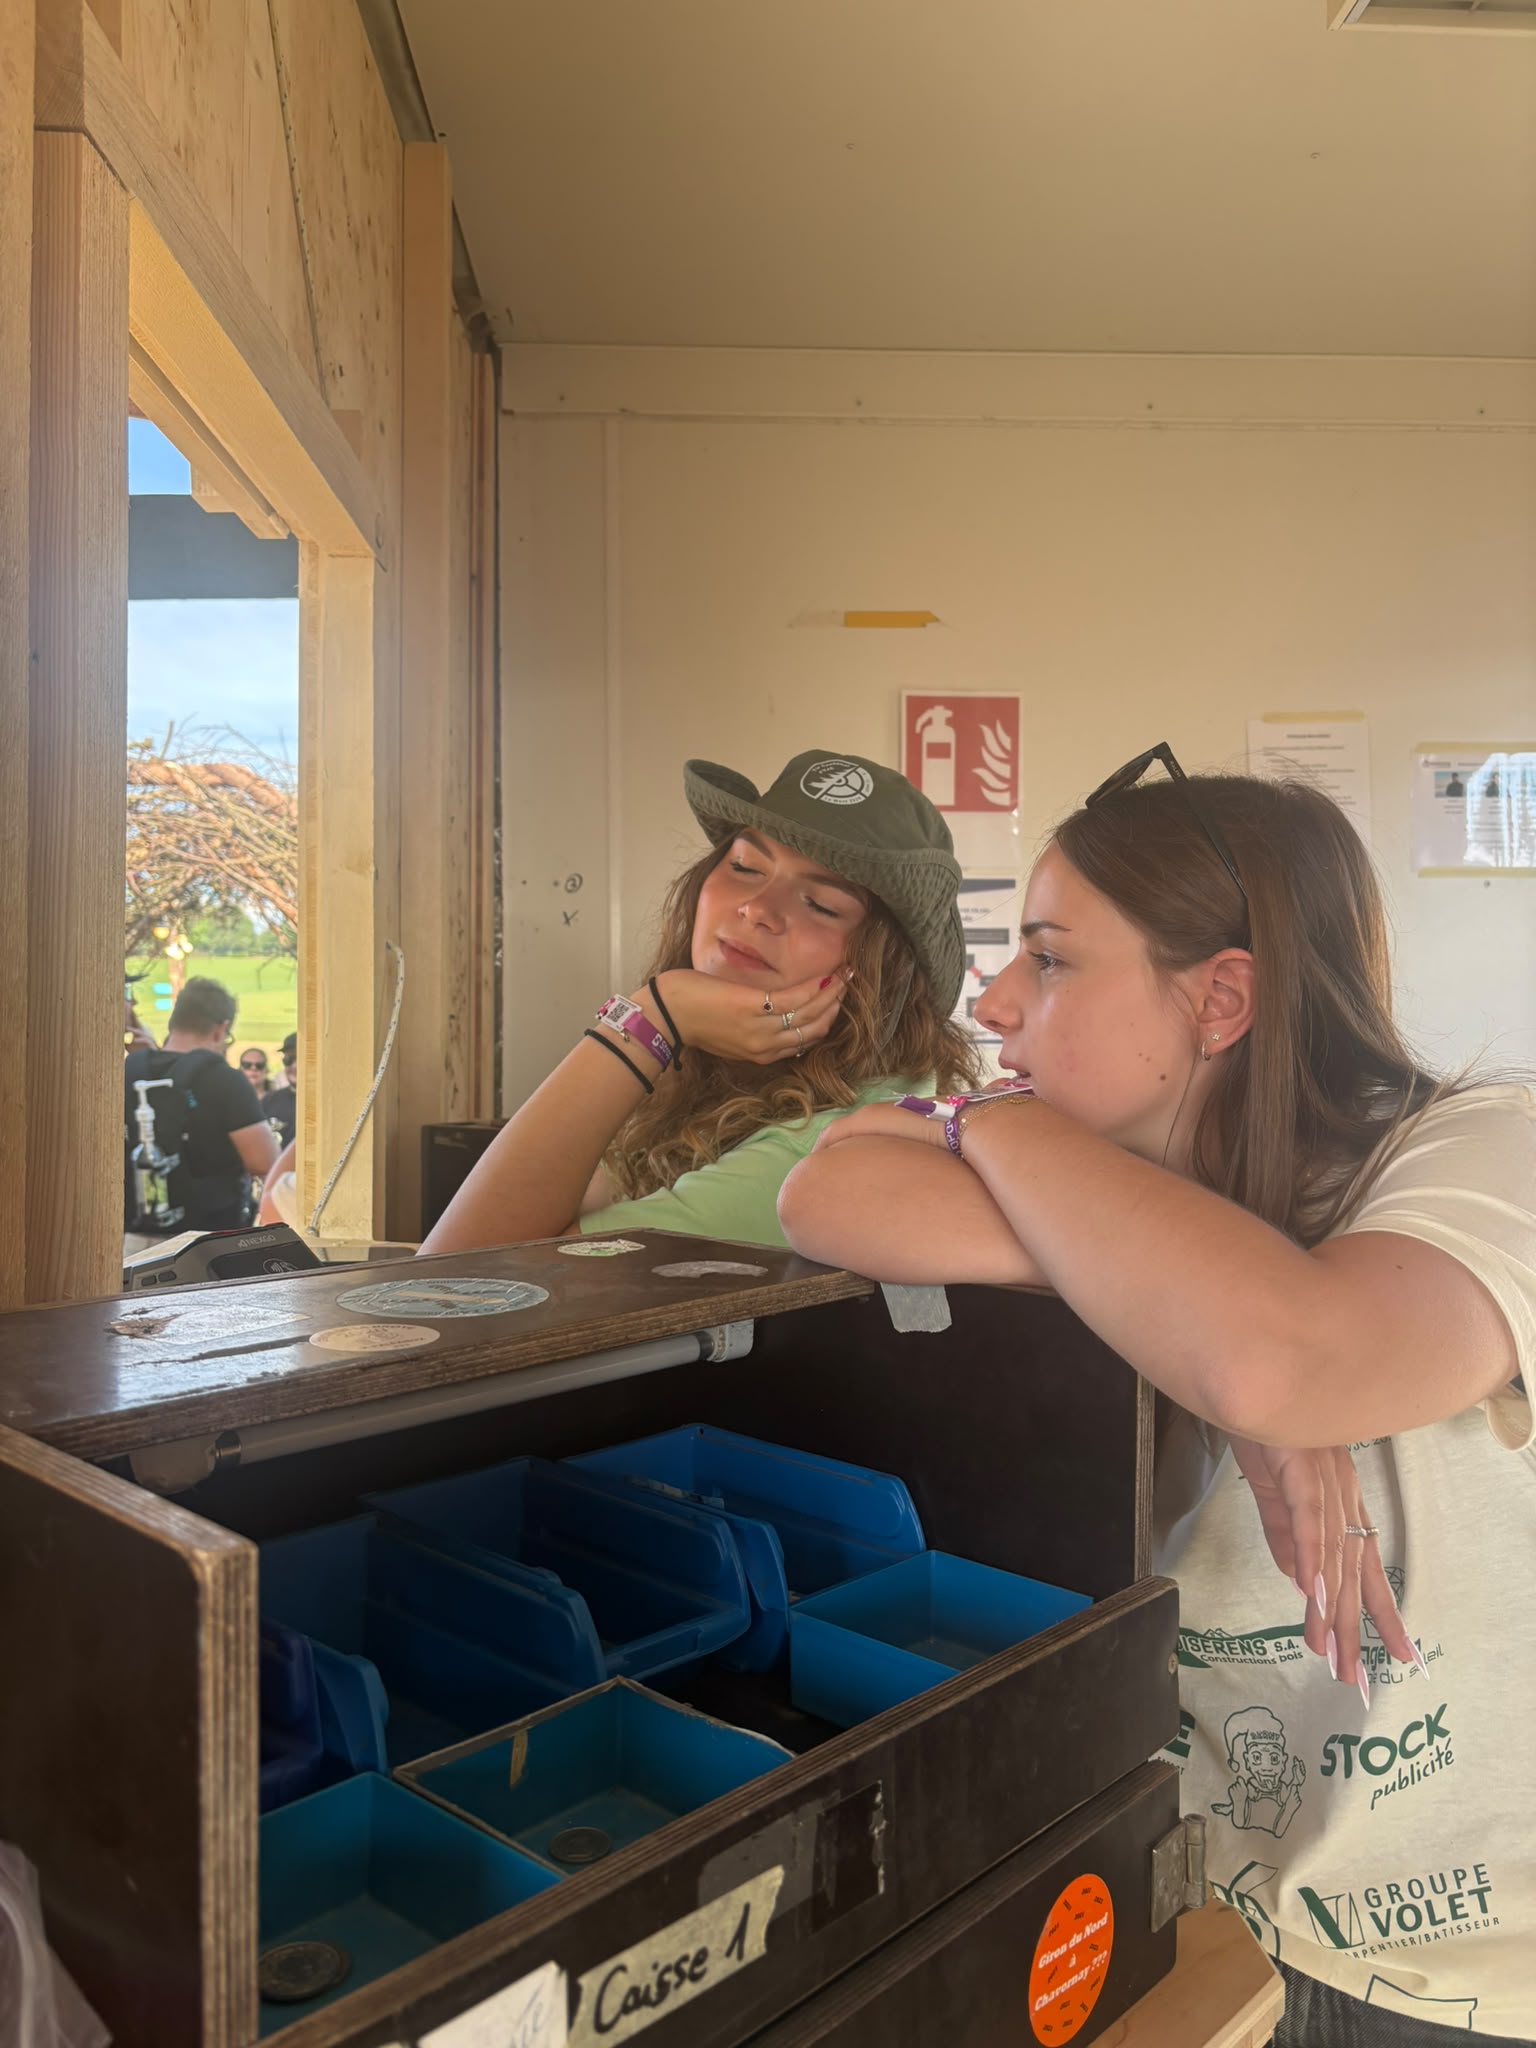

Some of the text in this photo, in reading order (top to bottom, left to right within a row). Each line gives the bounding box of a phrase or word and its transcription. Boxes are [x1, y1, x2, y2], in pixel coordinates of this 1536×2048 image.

[1200, 1651, 1304, 1665] Constructions bois
[1274, 1639, 1299, 1652] S.A.
[1409, 1643, 1444, 1678] sleil
[1320, 1703, 1450, 1779] STOCK
[1370, 1737, 1454, 1811] publicité
[1364, 1863, 1490, 1908] GROUPE
[1369, 1886, 1492, 1938] VOLET
[1038, 1943, 1067, 1969] Giron
[1069, 1932, 1083, 1949] du
[1084, 1912, 1108, 1939] Nord
[1345, 1917, 1500, 1959] RPENTIER/BATISSEUR
[594, 1946, 708, 2034] Caisse
[725, 1902, 750, 1961] 1
[1035, 1964, 1090, 2011] Chavornay
